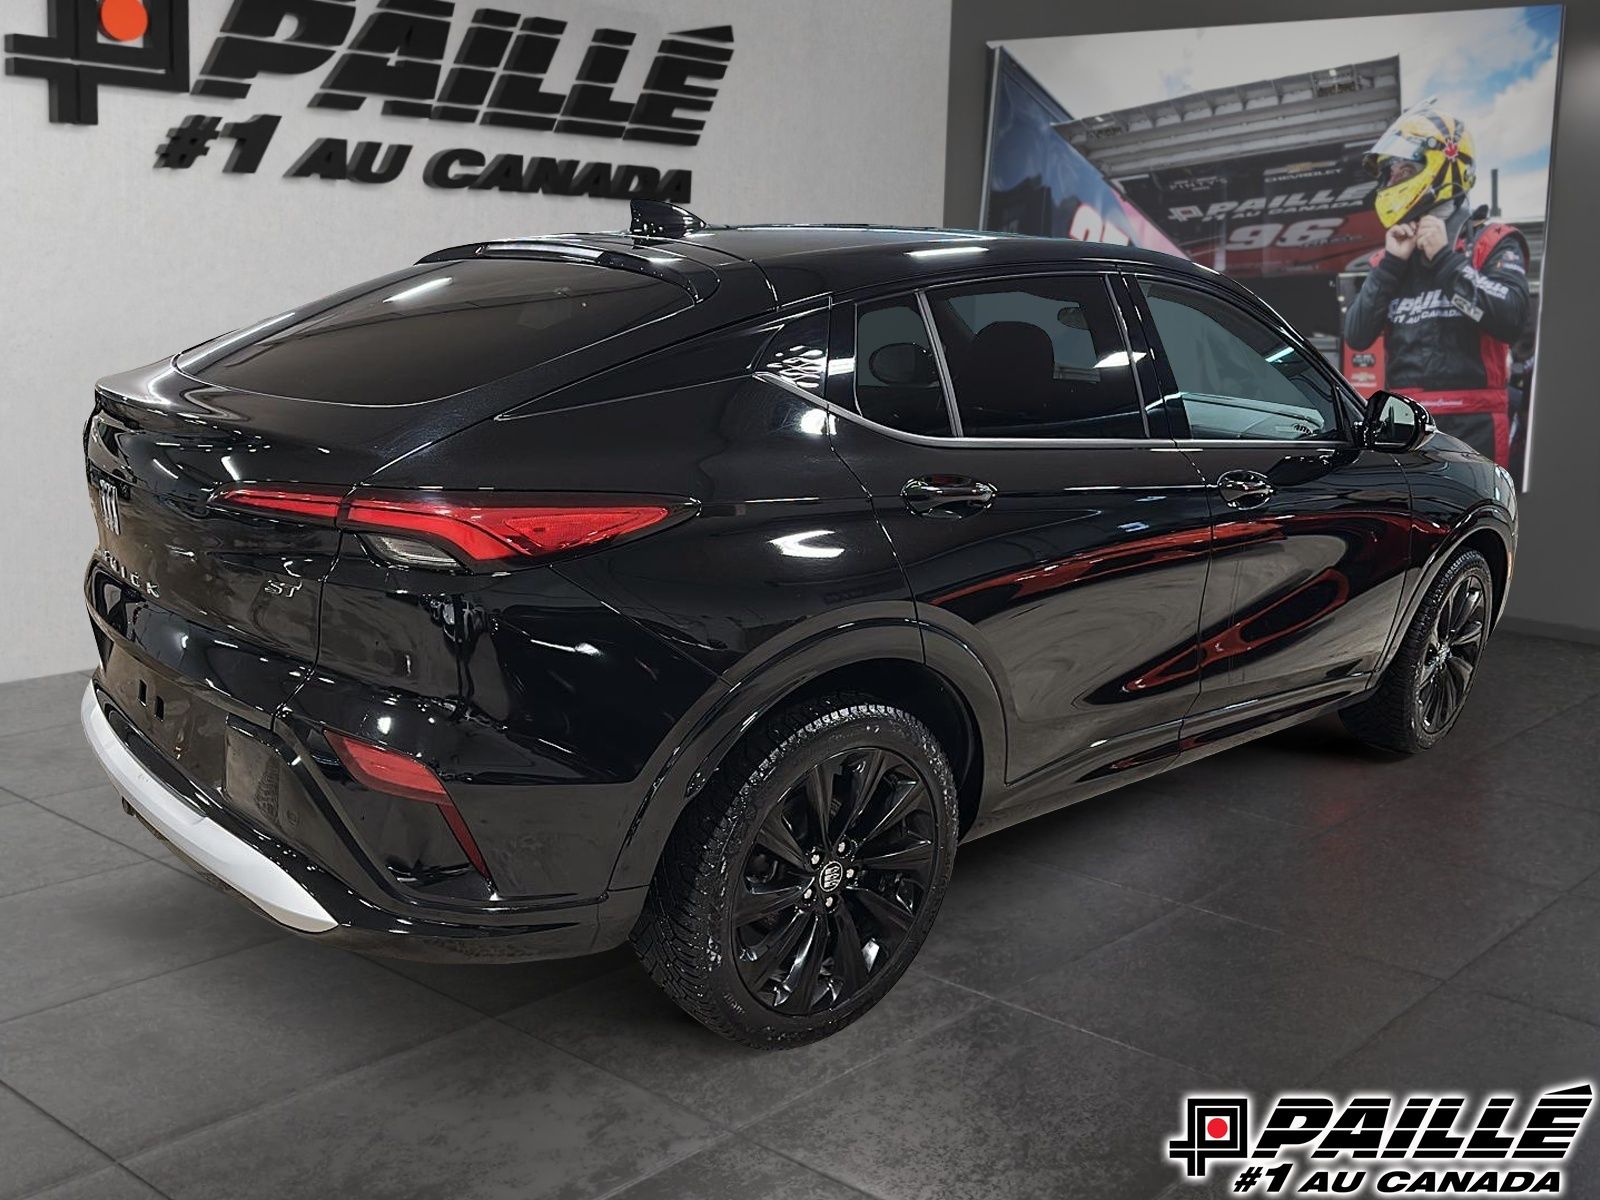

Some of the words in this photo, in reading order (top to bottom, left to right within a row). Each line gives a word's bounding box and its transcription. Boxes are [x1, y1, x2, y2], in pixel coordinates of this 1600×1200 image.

[153, 114, 282, 172] #1
[283, 138, 412, 182] AU
[422, 148, 693, 204] CANADA
[1264, 168, 1342, 184] CHEVROLET
[1268, 200, 1363, 215] CANADA
[1225, 217, 1345, 251] 96
[264, 580, 302, 599] ST
